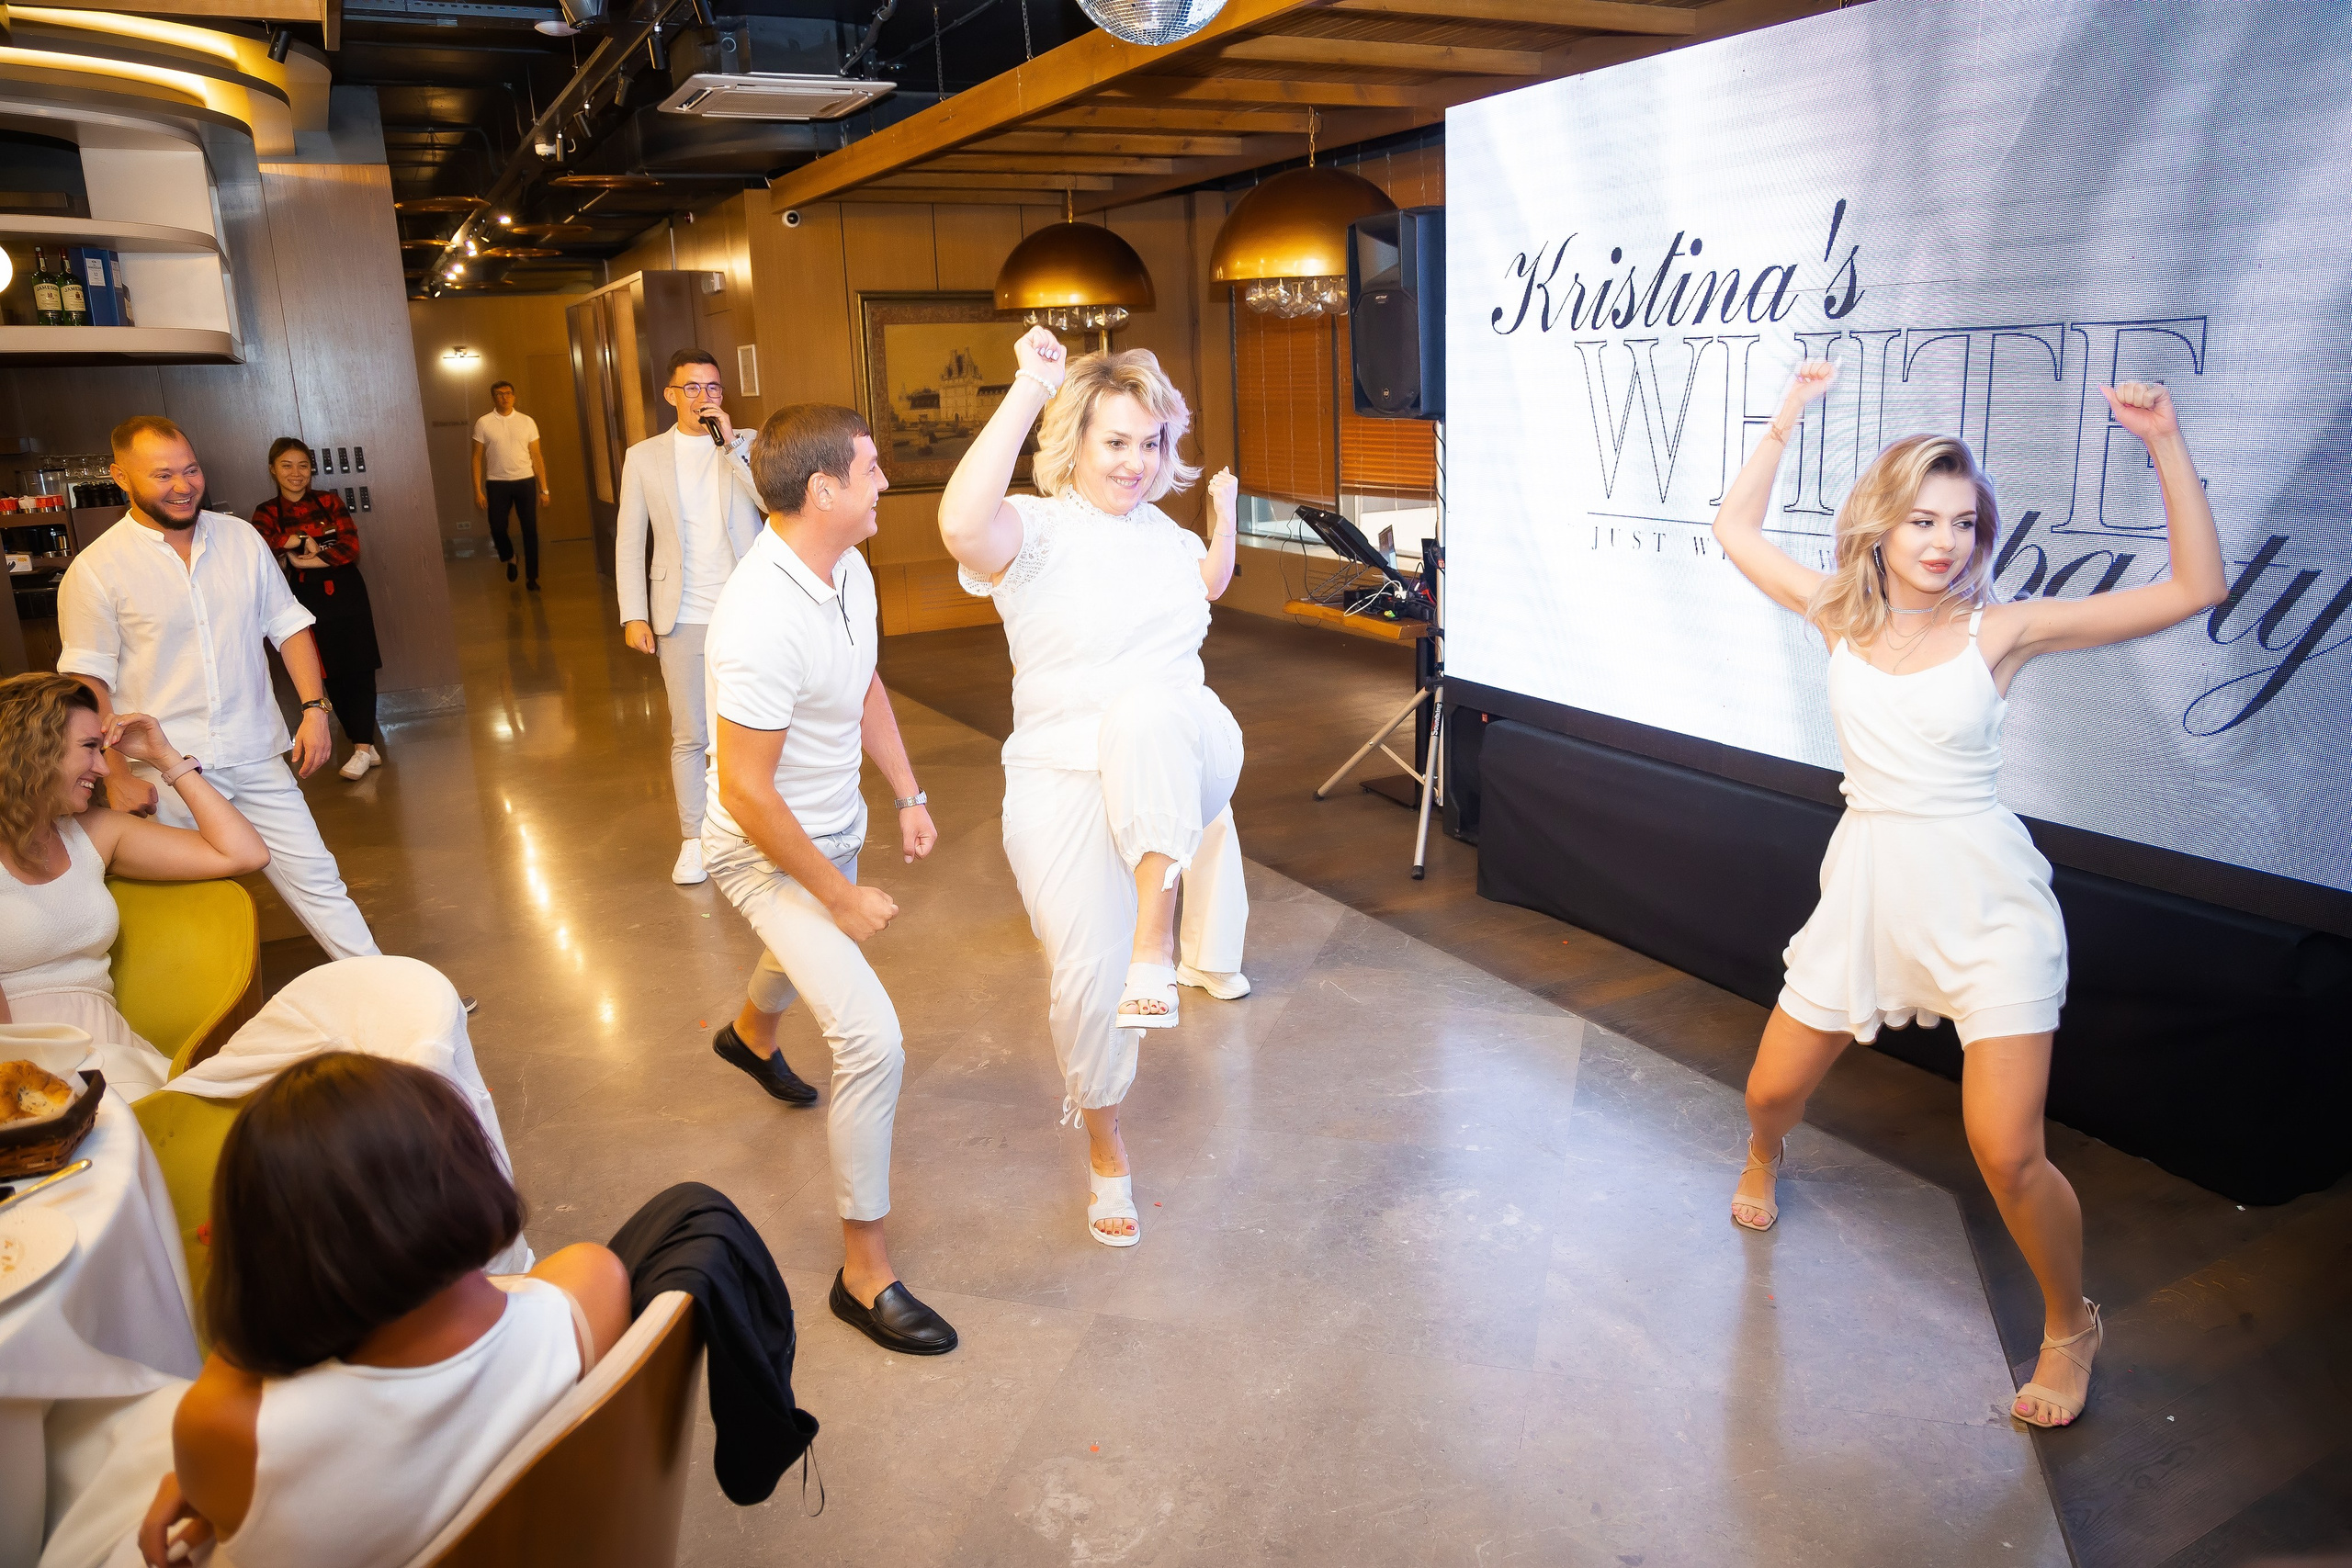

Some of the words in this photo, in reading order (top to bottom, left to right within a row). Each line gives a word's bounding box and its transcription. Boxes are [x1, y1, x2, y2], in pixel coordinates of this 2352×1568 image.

[1491, 198, 1866, 335] Kristina's
[1574, 315, 2207, 539] WHITE
[1591, 526, 1667, 553] JUST
[1991, 510, 2352, 737] paty
